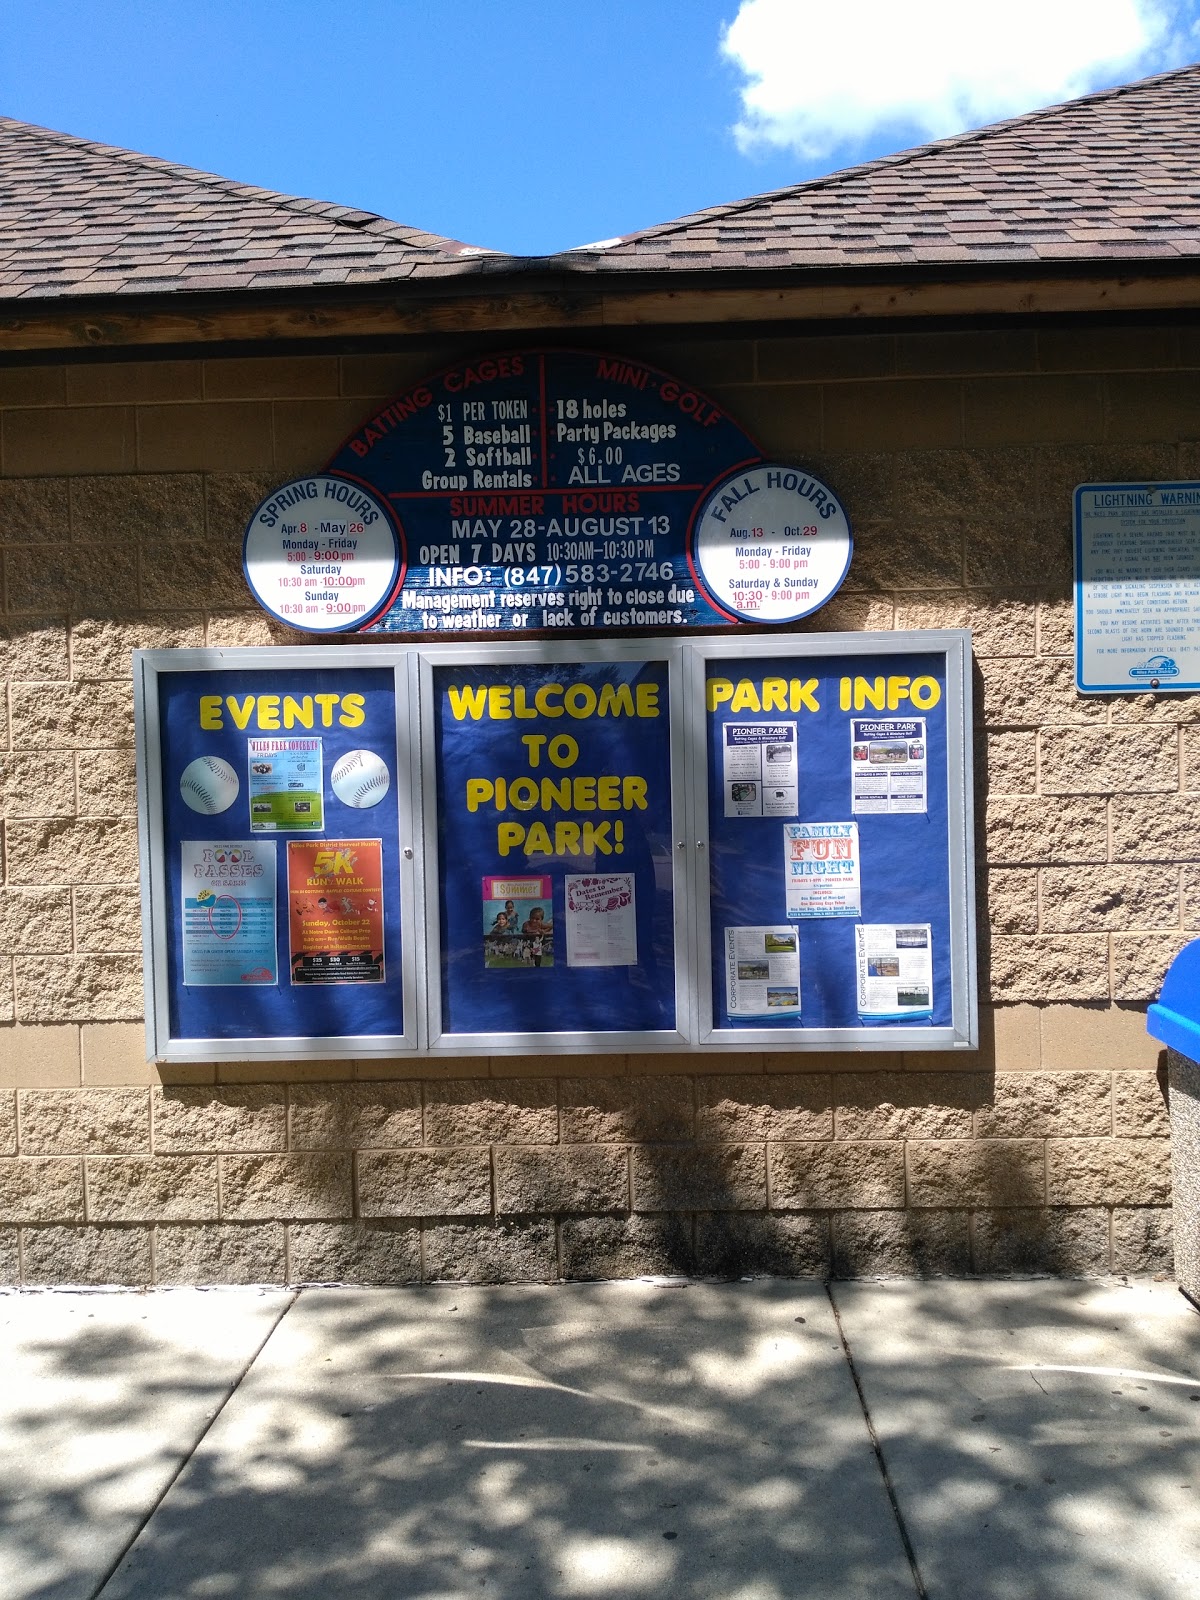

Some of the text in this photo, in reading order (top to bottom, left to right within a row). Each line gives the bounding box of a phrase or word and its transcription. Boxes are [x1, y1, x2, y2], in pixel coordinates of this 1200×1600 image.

[596, 358, 722, 427] MINI GOLF
[350, 356, 524, 458] BATTING CAGES
[438, 400, 528, 422] $1 PER TOKEN
[557, 399, 626, 420] 18 holes
[442, 424, 530, 446] 5 Baseball
[557, 421, 676, 444] Party Packages
[444, 446, 532, 468] 2 Softball
[578, 446, 622, 466] $6.00
[422, 469, 532, 491] Group Rentals
[568, 463, 680, 484] ALL AGES
[260, 481, 379, 528] SPRING HOURS
[450, 492, 640, 516] SUMMER HOURS
[711, 472, 836, 522] FALL HOURS
[1094, 494, 1152, 506] LIGHTNING
[320, 523, 346, 535] May
[350, 523, 364, 532] 26
[452, 520, 502, 538] MAY
[282, 539, 357, 551] Monday Friday
[420, 544, 460, 564] OPEN
[471, 544, 482, 563] 7
[492, 542, 536, 562] DAYS
[736, 546, 811, 558] Monday Friday
[288, 551, 354, 562] 5:00 9:00 pm
[740, 559, 808, 569] 5:00 9:00 pm
[300, 565, 342, 575] Saturday
[429, 566, 492, 586] INFO:
[278, 578, 302, 587] 10:30
[729, 578, 818, 589] Saturday & Sunday
[305, 591, 338, 601] Sunday
[402, 584, 694, 614] Management reserves right to close due
[733, 591, 809, 601] 10:30 9:00 pm
[280, 604, 302, 614] 10:30
[422, 606, 688, 629] to weather or lack of customers.
[448, 683, 660, 720] WELCOME
[706, 675, 942, 712] PARK INFO
[200, 694, 366, 730] EVENTS
[272, 740, 286, 751] FREE
[288, 740, 318, 750] CONCERTS
[522, 734, 580, 768] TO
[466, 776, 648, 812] PIONEER
[498, 820, 624, 856] PARK!
[789, 825, 852, 838] FAMILY
[203, 849, 254, 864] POOL
[790, 838, 853, 860] FUN
[194, 864, 264, 878] PASSES
[314, 852, 356, 875] 5K
[790, 860, 854, 875] NIGHT
[306, 877, 364, 886] RUN WALK
[500, 884, 538, 894] Summer
[576, 886, 596, 897] Dates
[584, 886, 624, 900] Remember
[728, 961, 737, 1009] CORPORATE
